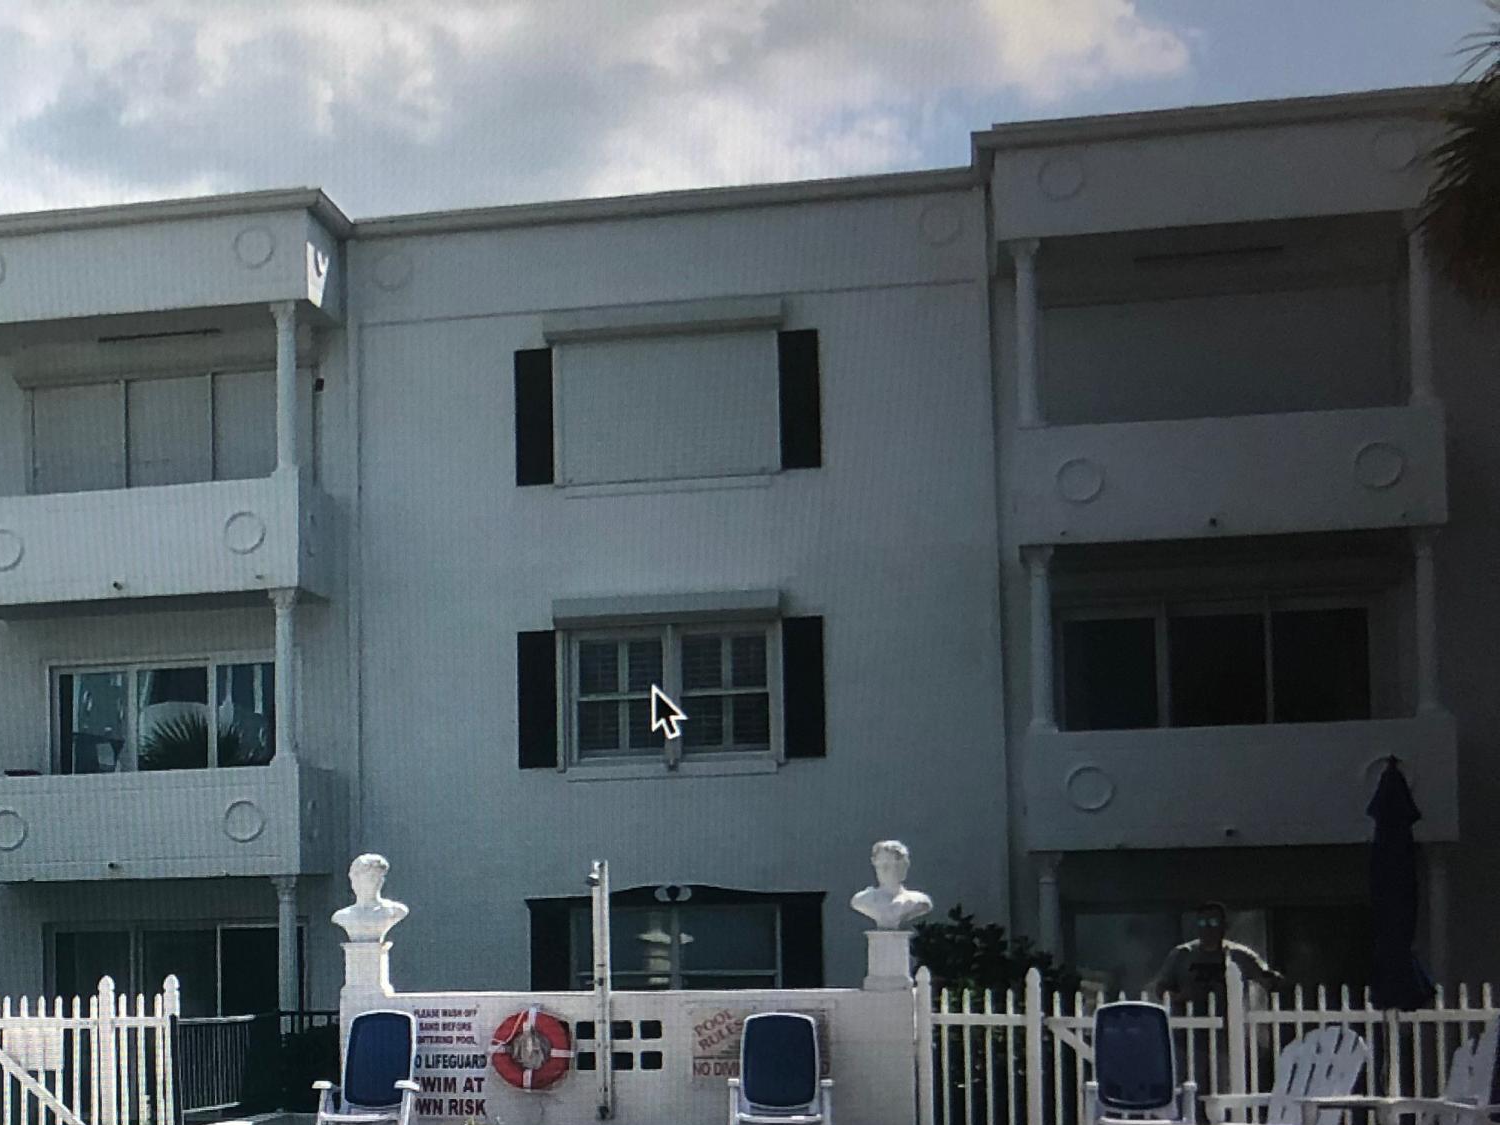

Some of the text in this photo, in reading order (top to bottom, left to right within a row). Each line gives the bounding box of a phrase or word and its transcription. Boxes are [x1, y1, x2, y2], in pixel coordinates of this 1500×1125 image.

[694, 1010, 734, 1037] POOL
[425, 1054, 488, 1069] LIFEGUARD
[693, 1062, 711, 1076] NO
[463, 1077, 485, 1093] AT
[448, 1099, 487, 1116] RISK
